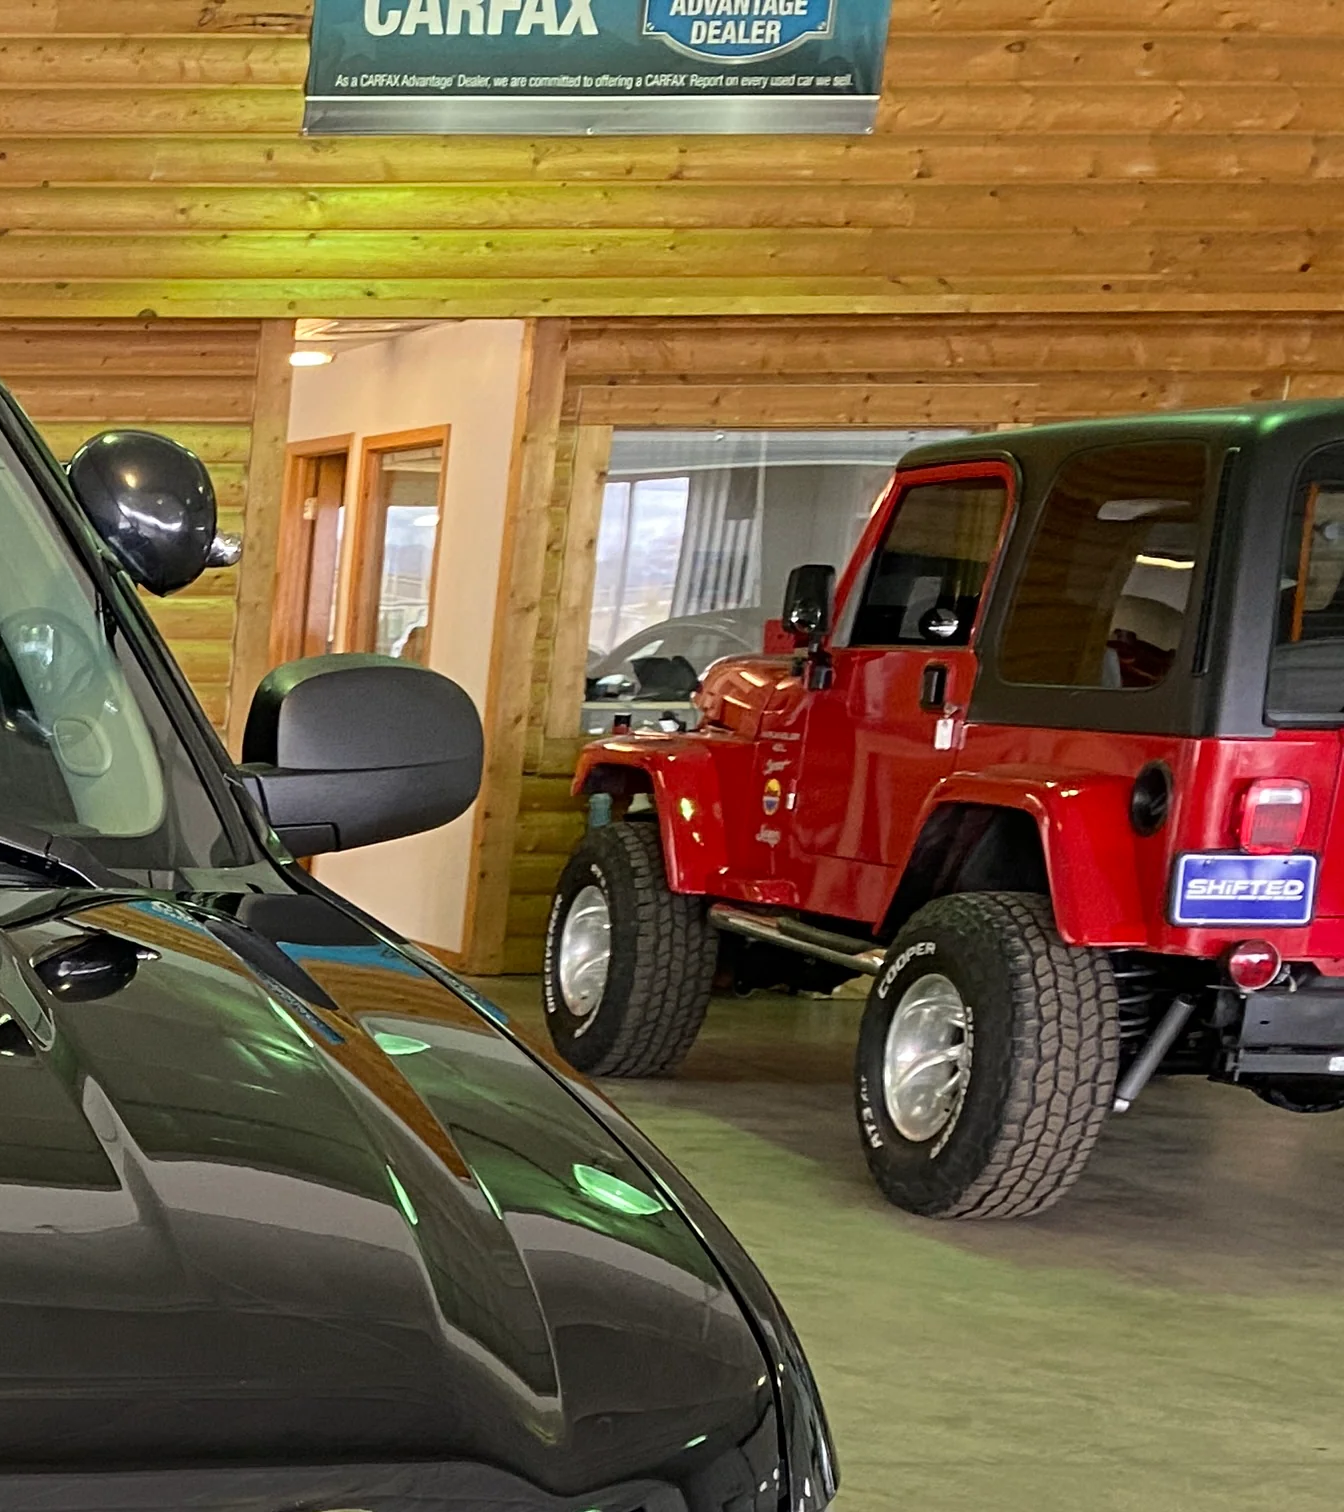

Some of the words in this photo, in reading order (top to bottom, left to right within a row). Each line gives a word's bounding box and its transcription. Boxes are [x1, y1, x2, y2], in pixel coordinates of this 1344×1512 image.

[364, 0, 599, 37] CARFAX
[670, 0, 808, 17] ADVANTAGE
[690, 20, 782, 45] DEALER
[335, 74, 350, 87] As
[351, 77, 359, 87] a
[360, 74, 401, 88] CARFAX
[493, 77, 509, 87] we
[510, 77, 528, 87] are
[583, 75, 594, 88] to
[595, 74, 634, 90] offering
[635, 77, 643, 87] a
[689, 74, 724, 89] Report
[725, 76, 739, 87] on
[740, 75, 770, 89] every
[797, 76, 815, 86] car
[877, 941, 937, 1000] COOPER
